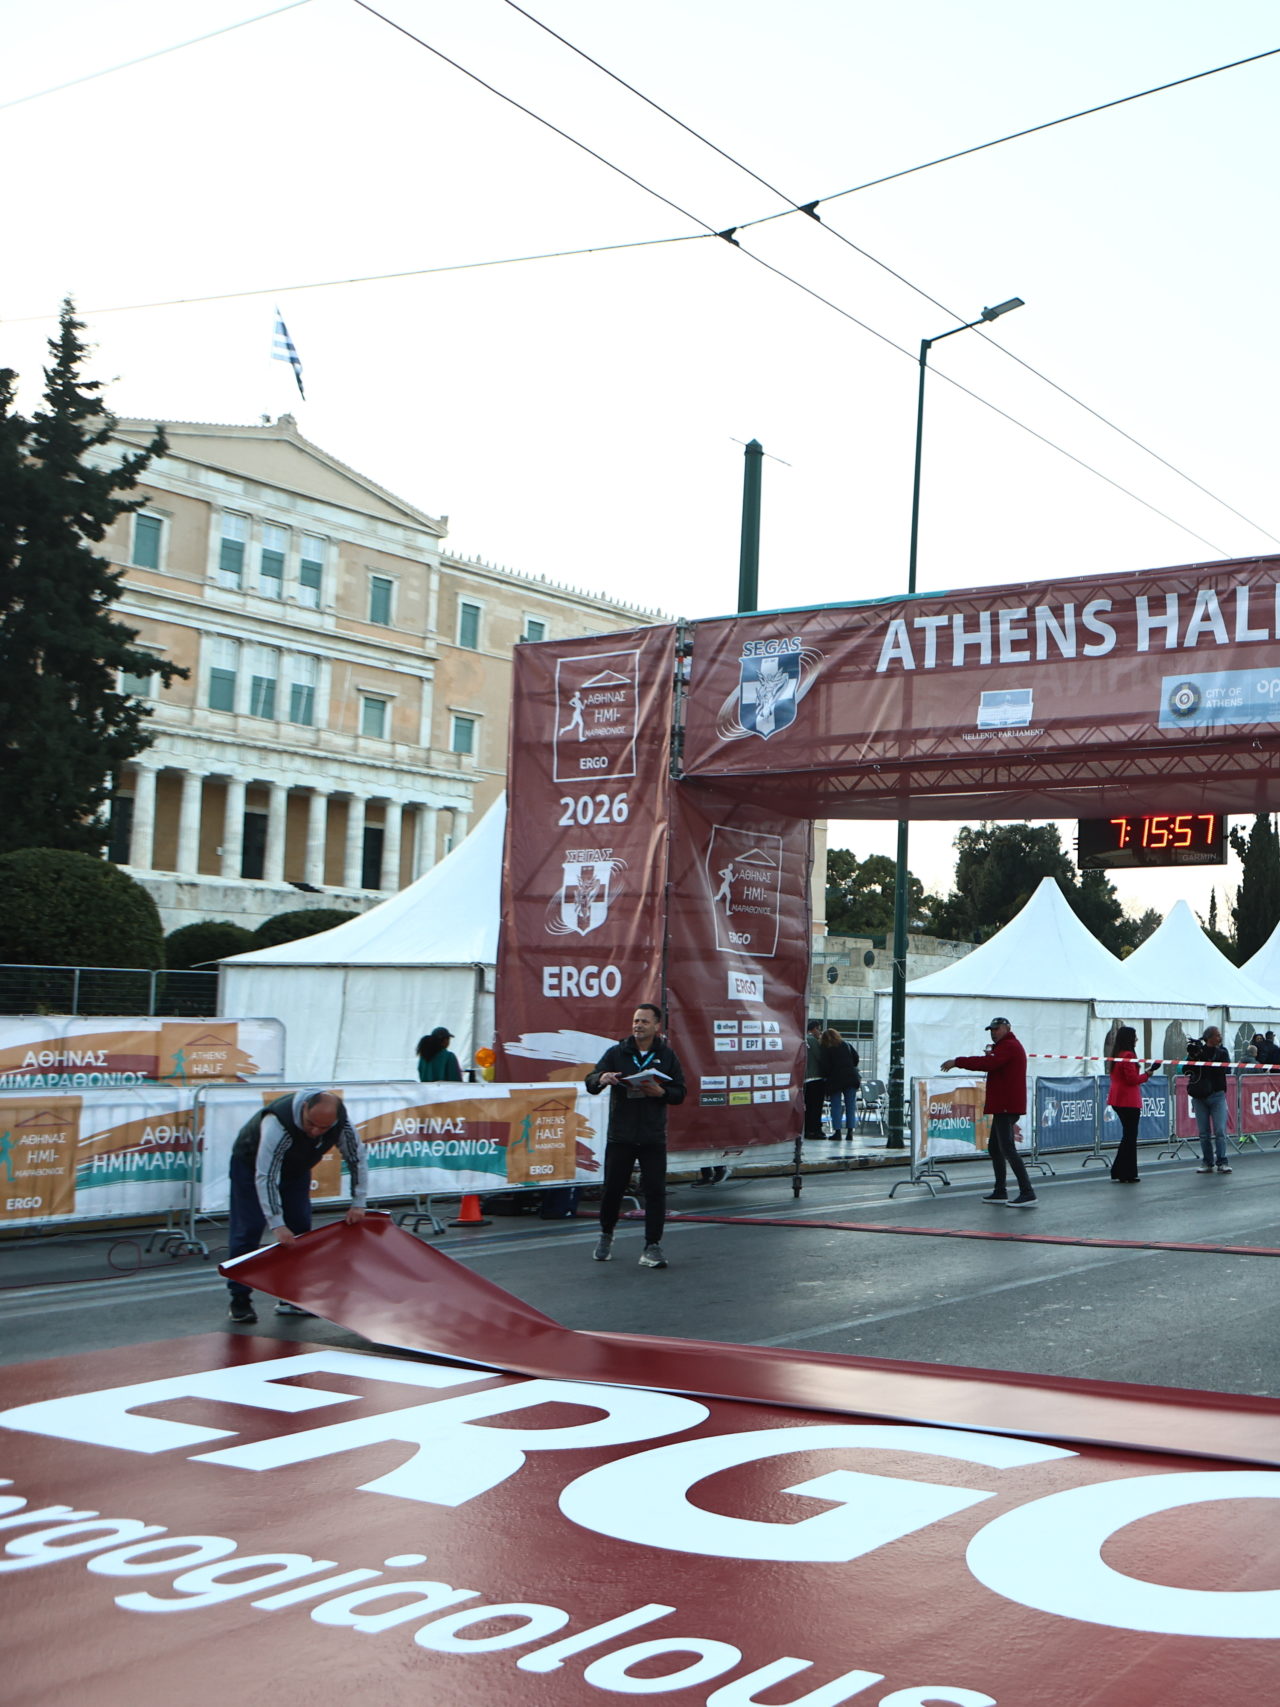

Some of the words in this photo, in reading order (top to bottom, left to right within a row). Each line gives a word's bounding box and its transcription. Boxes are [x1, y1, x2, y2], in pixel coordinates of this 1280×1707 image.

[876, 599, 1117, 672] ATHENS
[742, 637, 802, 657] SEGAS
[588, 691, 626, 705] ΑΘΗΝΑΣ
[1206, 688, 1226, 699] CITY
[1228, 688, 1242, 697] OF
[1206, 697, 1243, 708] ATHENS
[962, 732, 997, 741] HELLENIC
[998, 728, 1045, 739] PARLIAMENT
[579, 756, 608, 770] ERGO
[558, 792, 629, 827] 2026
[1110, 814, 1215, 848] 7:15:57
[565, 848, 613, 863] ΣΕΓΑΣ
[1182, 853, 1217, 861] GARMIN
[728, 931, 751, 945] ERGO
[542, 965, 622, 997] ERGO
[735, 978, 757, 995] ERGO
[22, 1050, 109, 1067] ΑΘΗΝΑΣ
[192, 1063, 224, 1074] HALF
[1060, 1100, 1093, 1122] ΣΕΓΑΣ
[392, 1117, 467, 1135] ΑΘΗΝΑΣ
[535, 1115, 566, 1126] ATHENS
[536, 1128, 564, 1140] HALF
[529, 1165, 554, 1175] ERGO
[6, 1196, 42, 1210] ERGO
